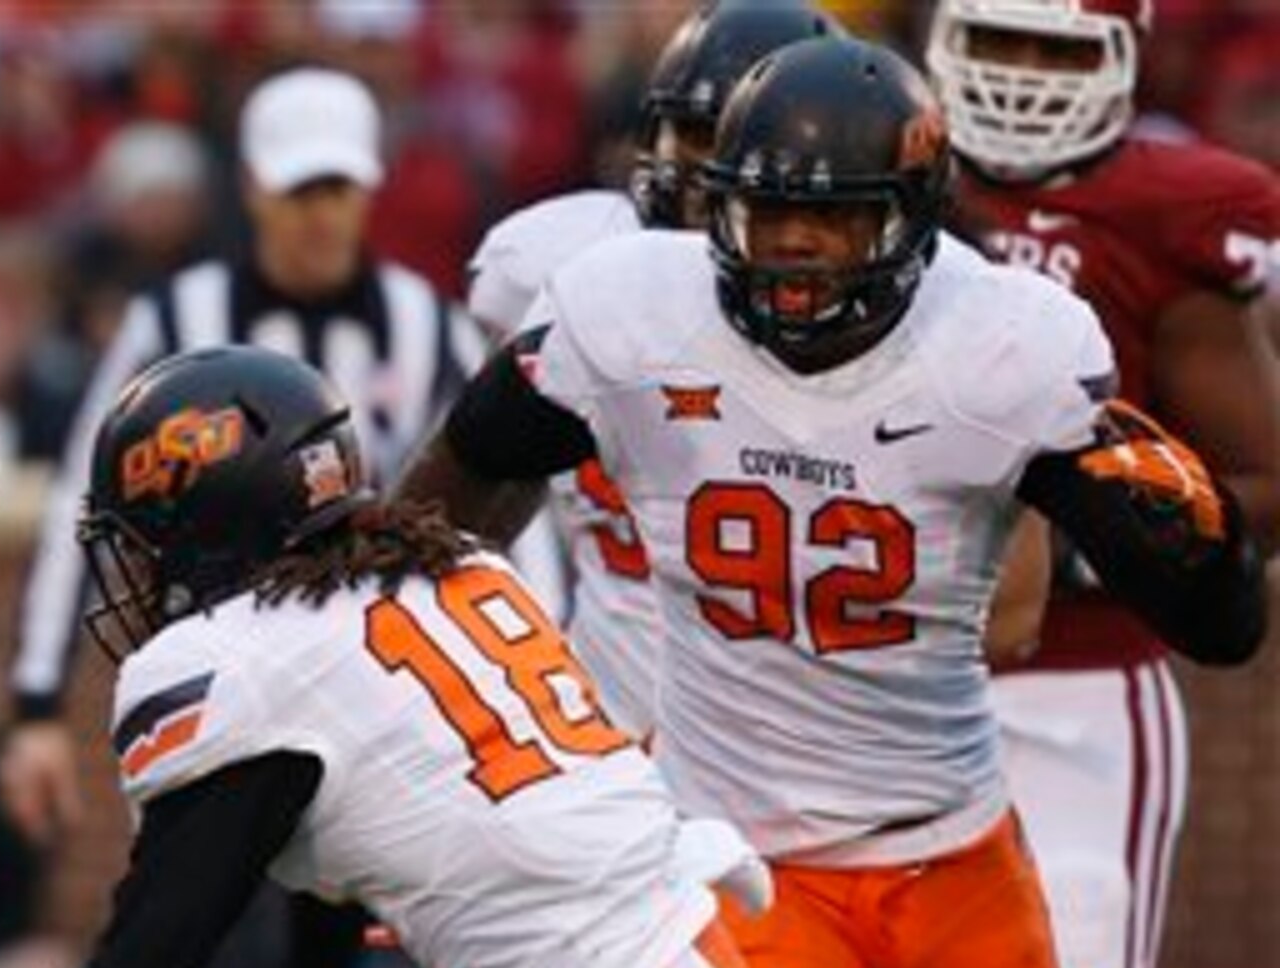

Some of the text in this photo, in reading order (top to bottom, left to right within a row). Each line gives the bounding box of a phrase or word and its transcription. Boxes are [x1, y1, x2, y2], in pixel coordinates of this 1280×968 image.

[740, 447, 857, 491] COWBOYS
[684, 480, 917, 655] 92
[364, 563, 640, 803] 18
